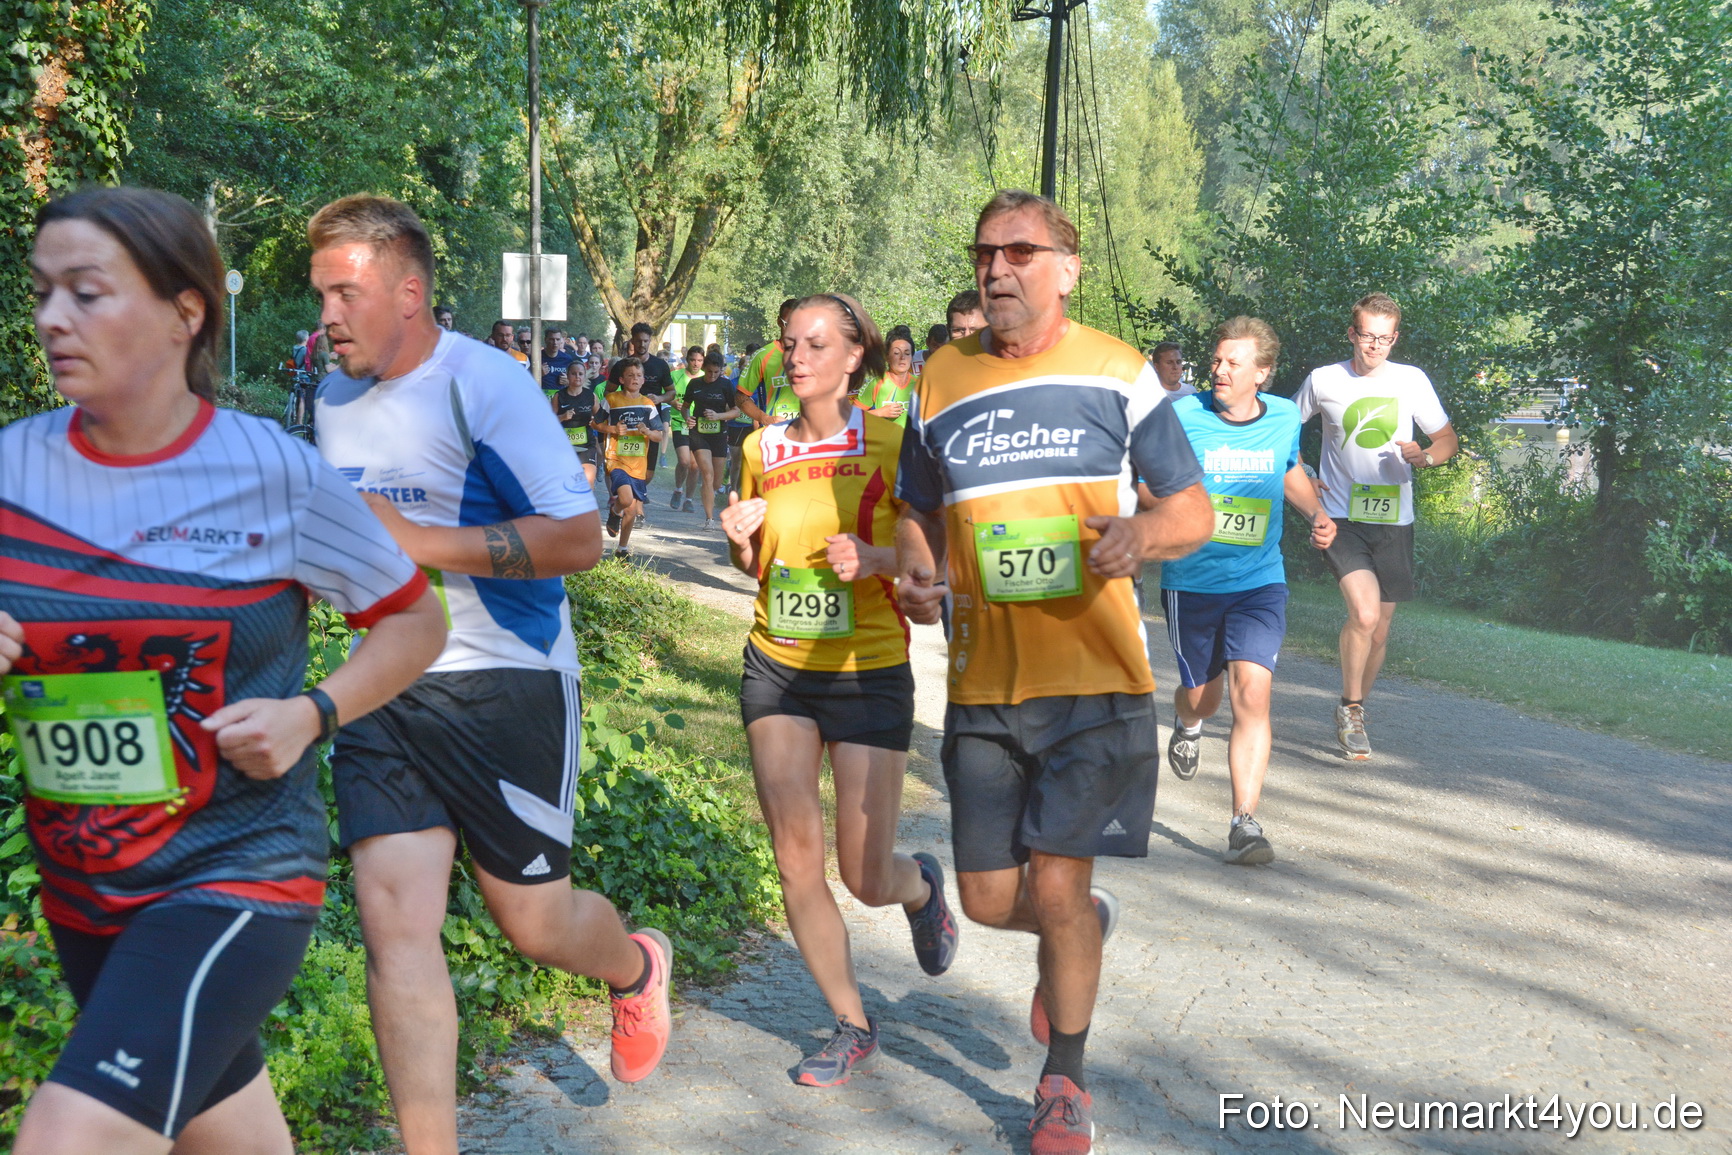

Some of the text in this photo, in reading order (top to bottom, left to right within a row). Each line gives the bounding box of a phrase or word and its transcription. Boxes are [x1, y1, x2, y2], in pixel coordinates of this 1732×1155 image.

[700, 422, 718, 430] 2032
[623, 442, 640, 451] 579
[966, 423, 1087, 457] Fischer
[978, 447, 1079, 467] AUTOMOBILE
[1203, 457, 1276, 472] NEUMARKT
[762, 461, 867, 494] MAX BÖGL
[1362, 497, 1391, 513] 175
[1222, 512, 1256, 532] 791
[132, 526, 243, 545] NEUMARKT
[998, 547, 1056, 578] 570
[1035, 577, 1055, 585] Otto
[775, 590, 842, 619] 1298
[778, 616, 838, 627] Gerngross Judith
[26, 720, 145, 767] 1908
